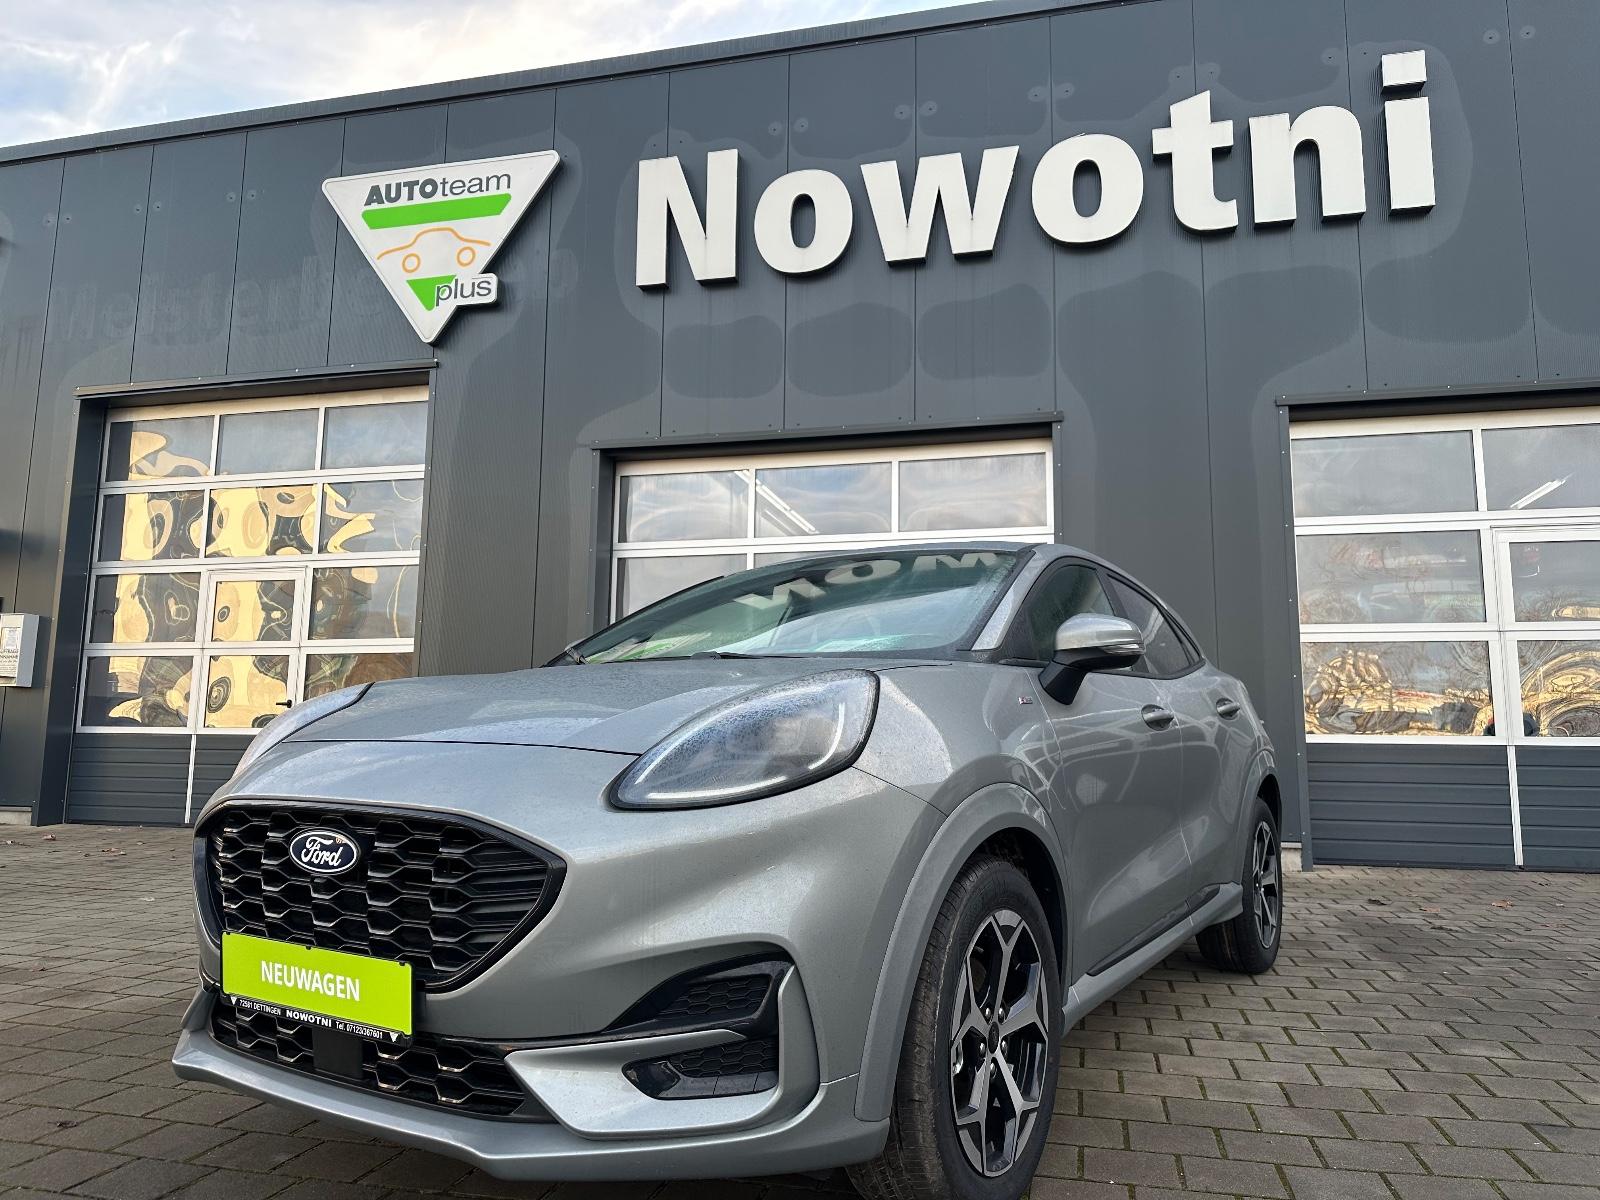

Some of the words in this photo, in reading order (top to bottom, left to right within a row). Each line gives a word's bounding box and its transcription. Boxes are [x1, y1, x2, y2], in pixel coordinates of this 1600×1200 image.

[635, 49, 1436, 289] Nowotni
[435, 278, 492, 307] plus
[300, 836, 344, 867] Ford
[261, 960, 360, 1001] NEUWAGEN
[253, 1002, 281, 1016] DETTINGEN
[286, 1009, 332, 1028] NOWOTNI
[335, 1021, 346, 1031] Tel.
